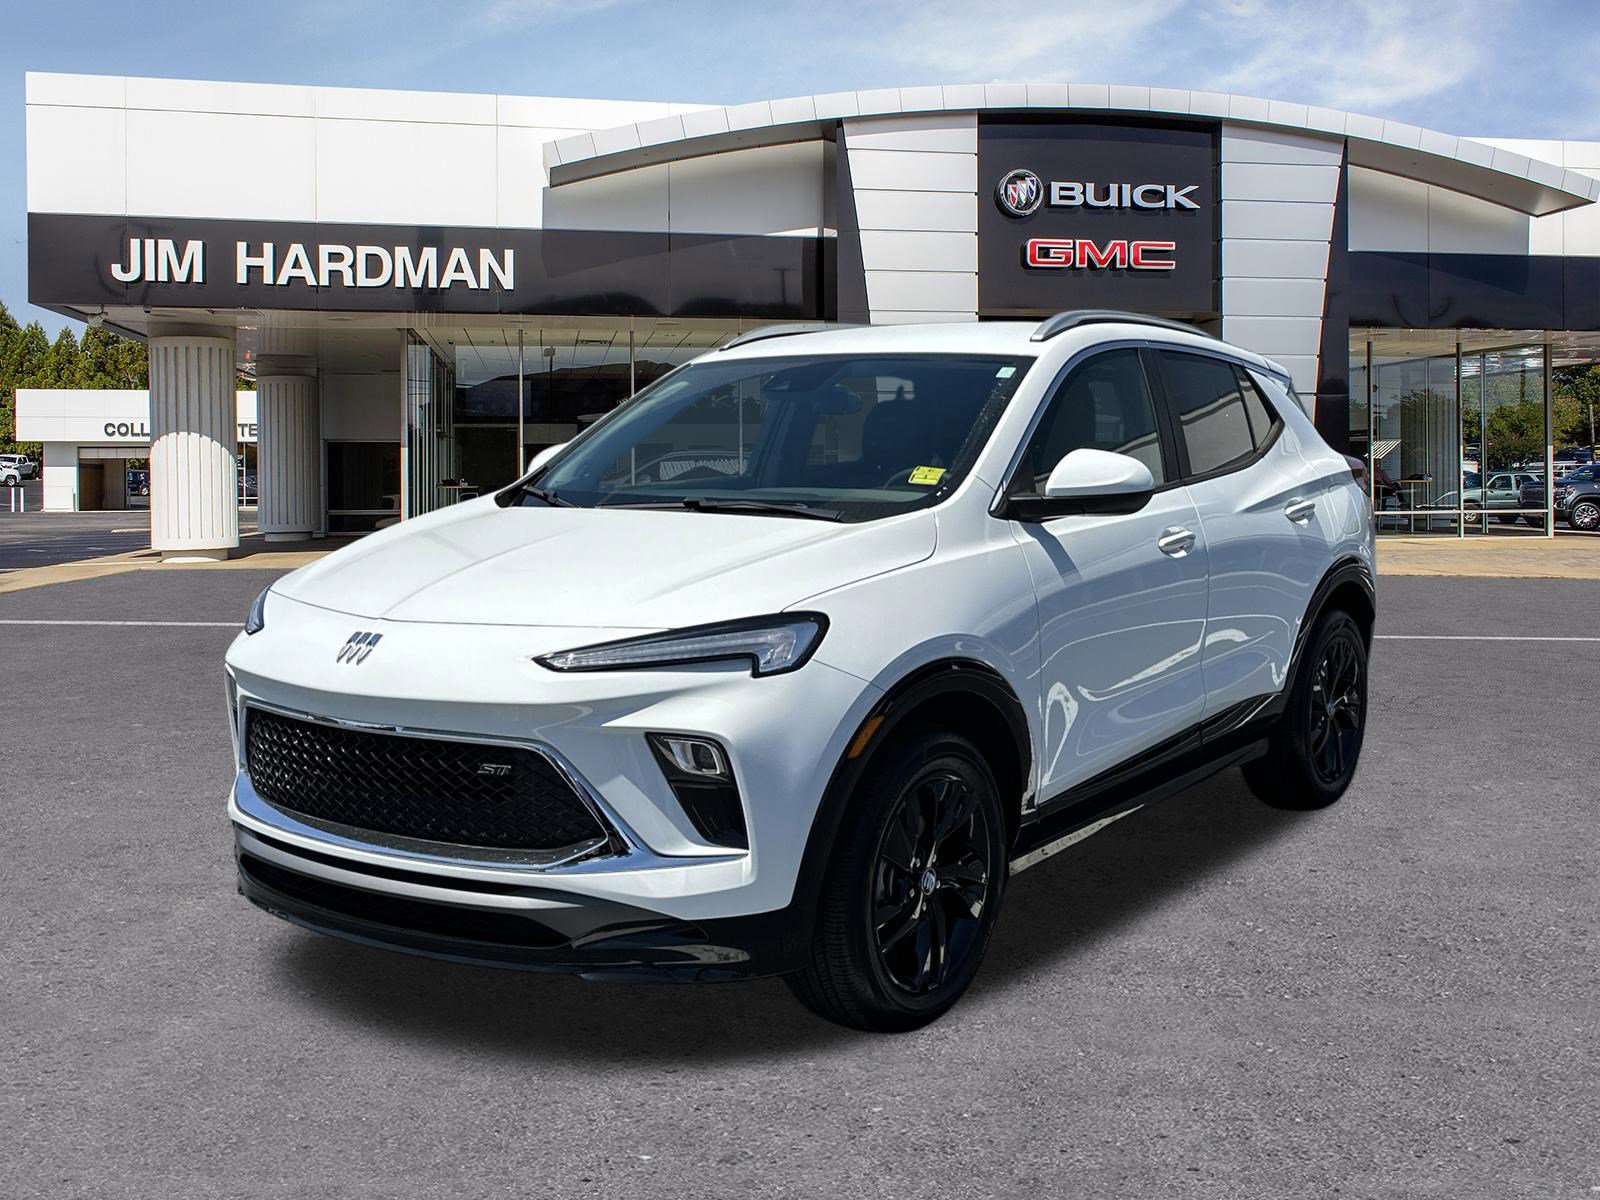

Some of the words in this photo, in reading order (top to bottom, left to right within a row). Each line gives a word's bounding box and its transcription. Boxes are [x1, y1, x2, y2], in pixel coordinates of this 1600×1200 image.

[1050, 181, 1200, 209] BUICK
[111, 238, 204, 283] JIM
[236, 241, 514, 290] HARDMAN
[1027, 238, 1176, 269] GMC
